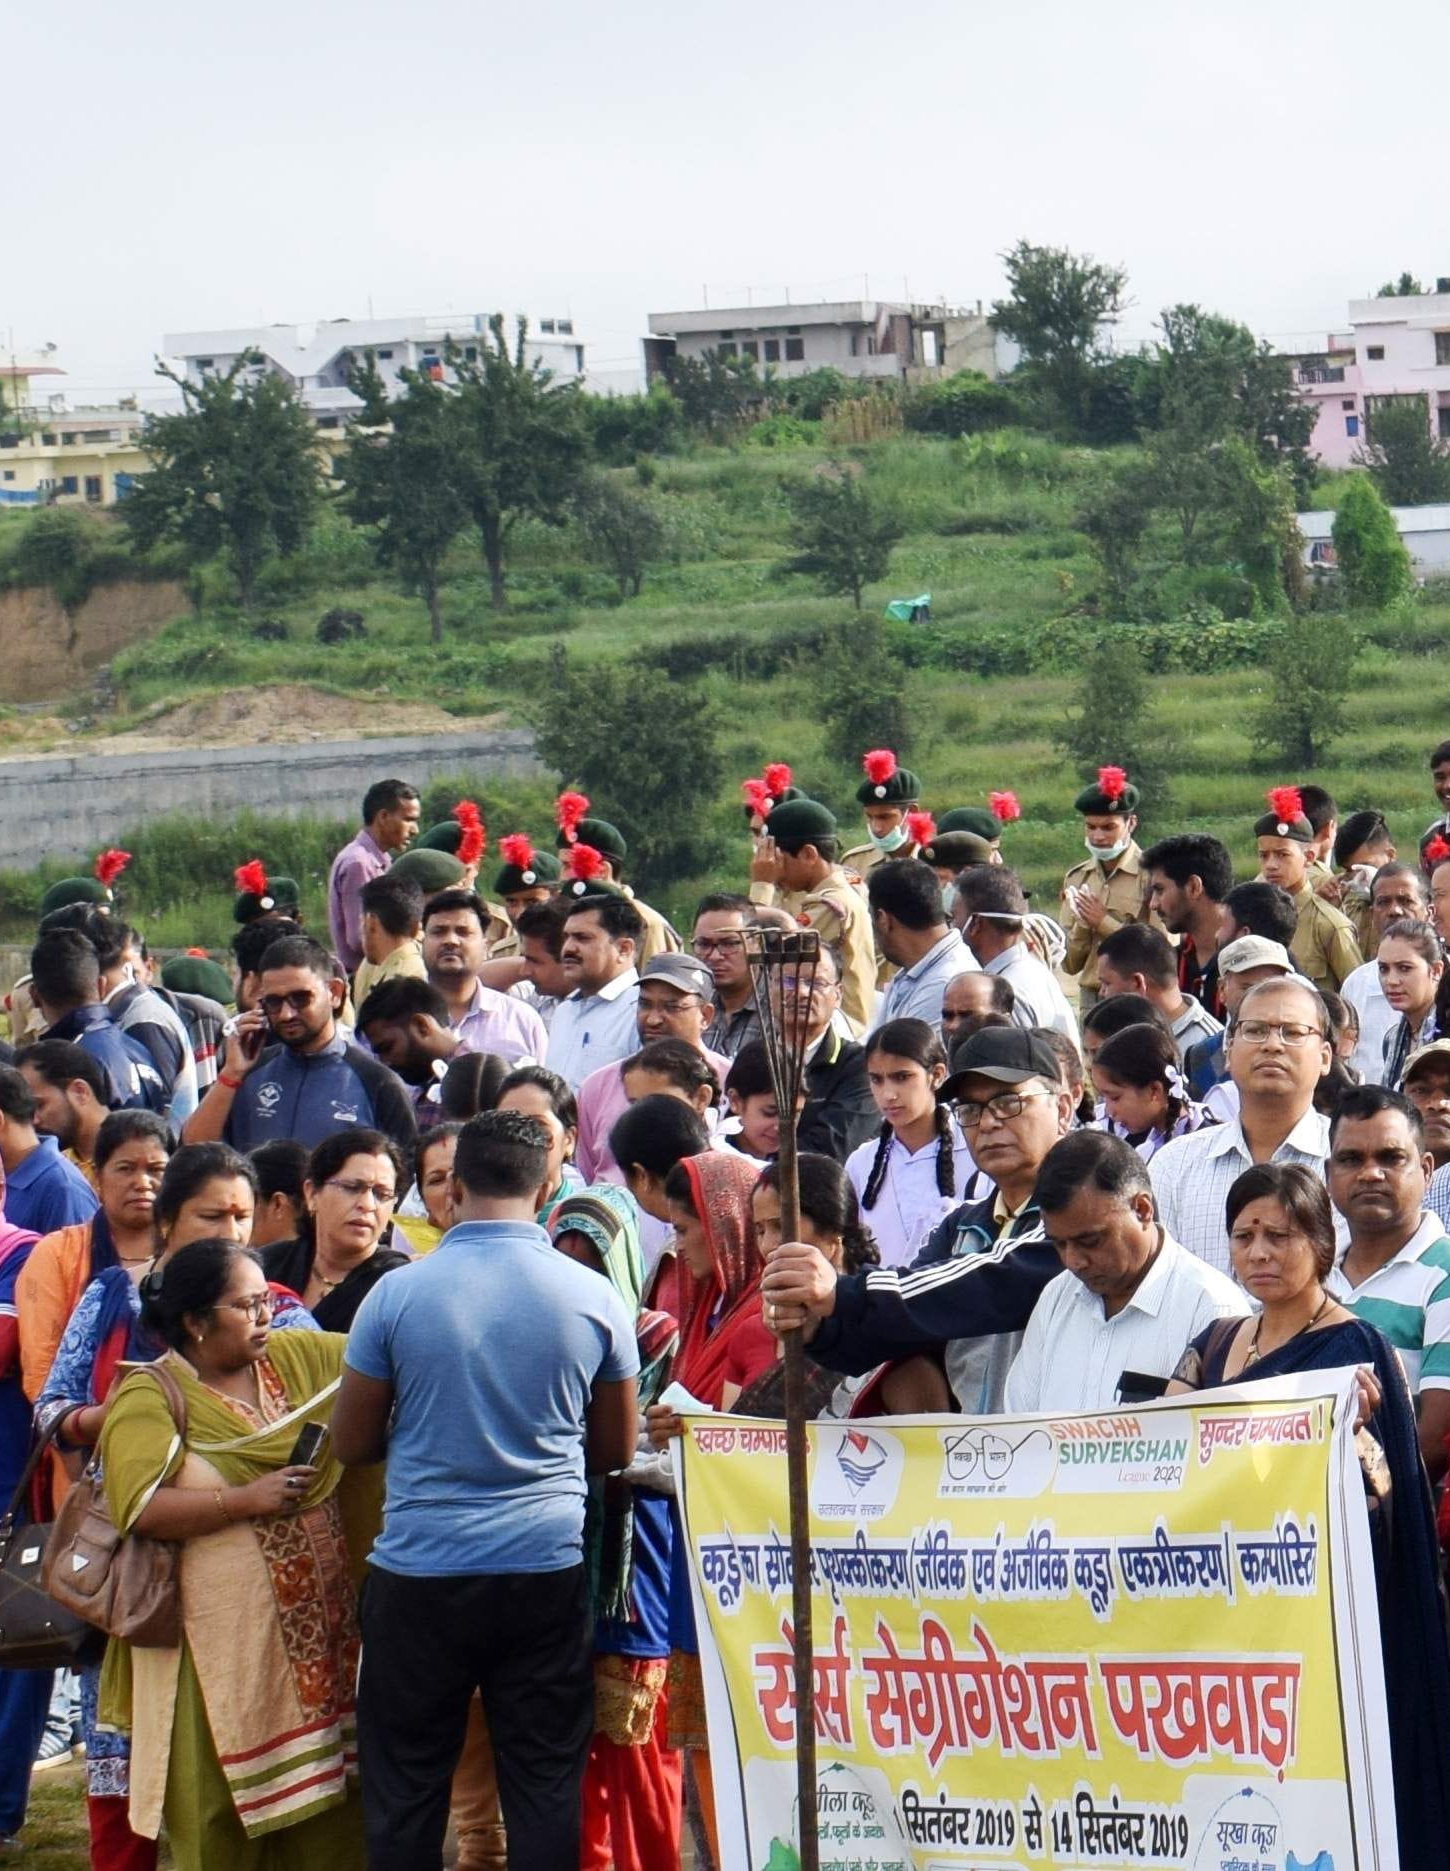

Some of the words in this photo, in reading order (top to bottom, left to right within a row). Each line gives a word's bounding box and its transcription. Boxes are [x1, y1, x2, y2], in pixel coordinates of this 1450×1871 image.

[693, 1427, 736, 1454] स्वच्छ
[1051, 1417, 1142, 1441] SWACHH
[1200, 1418, 1247, 1464] सुन्दर
[1059, 1440, 1187, 1465] SURVEKSHAN
[1153, 1466, 1182, 1485] 2020
[972, 1532, 1001, 1594] एवं
[1000, 1529, 1070, 1592] अजैविक
[862, 1618, 1098, 1767] सेग्रीगेशन
[1099, 1661, 1302, 1784] पखवाड़ा
[902, 1789, 971, 1846] सितंबर
[975, 1808, 1016, 1847] 2019
[1022, 1794, 1043, 1850] से
[1051, 1810, 1073, 1853] 14
[1076, 1791, 1145, 1857] सितंबर
[1150, 1813, 1189, 1859] 2019
[1217, 1821, 1247, 1851] सूखा
